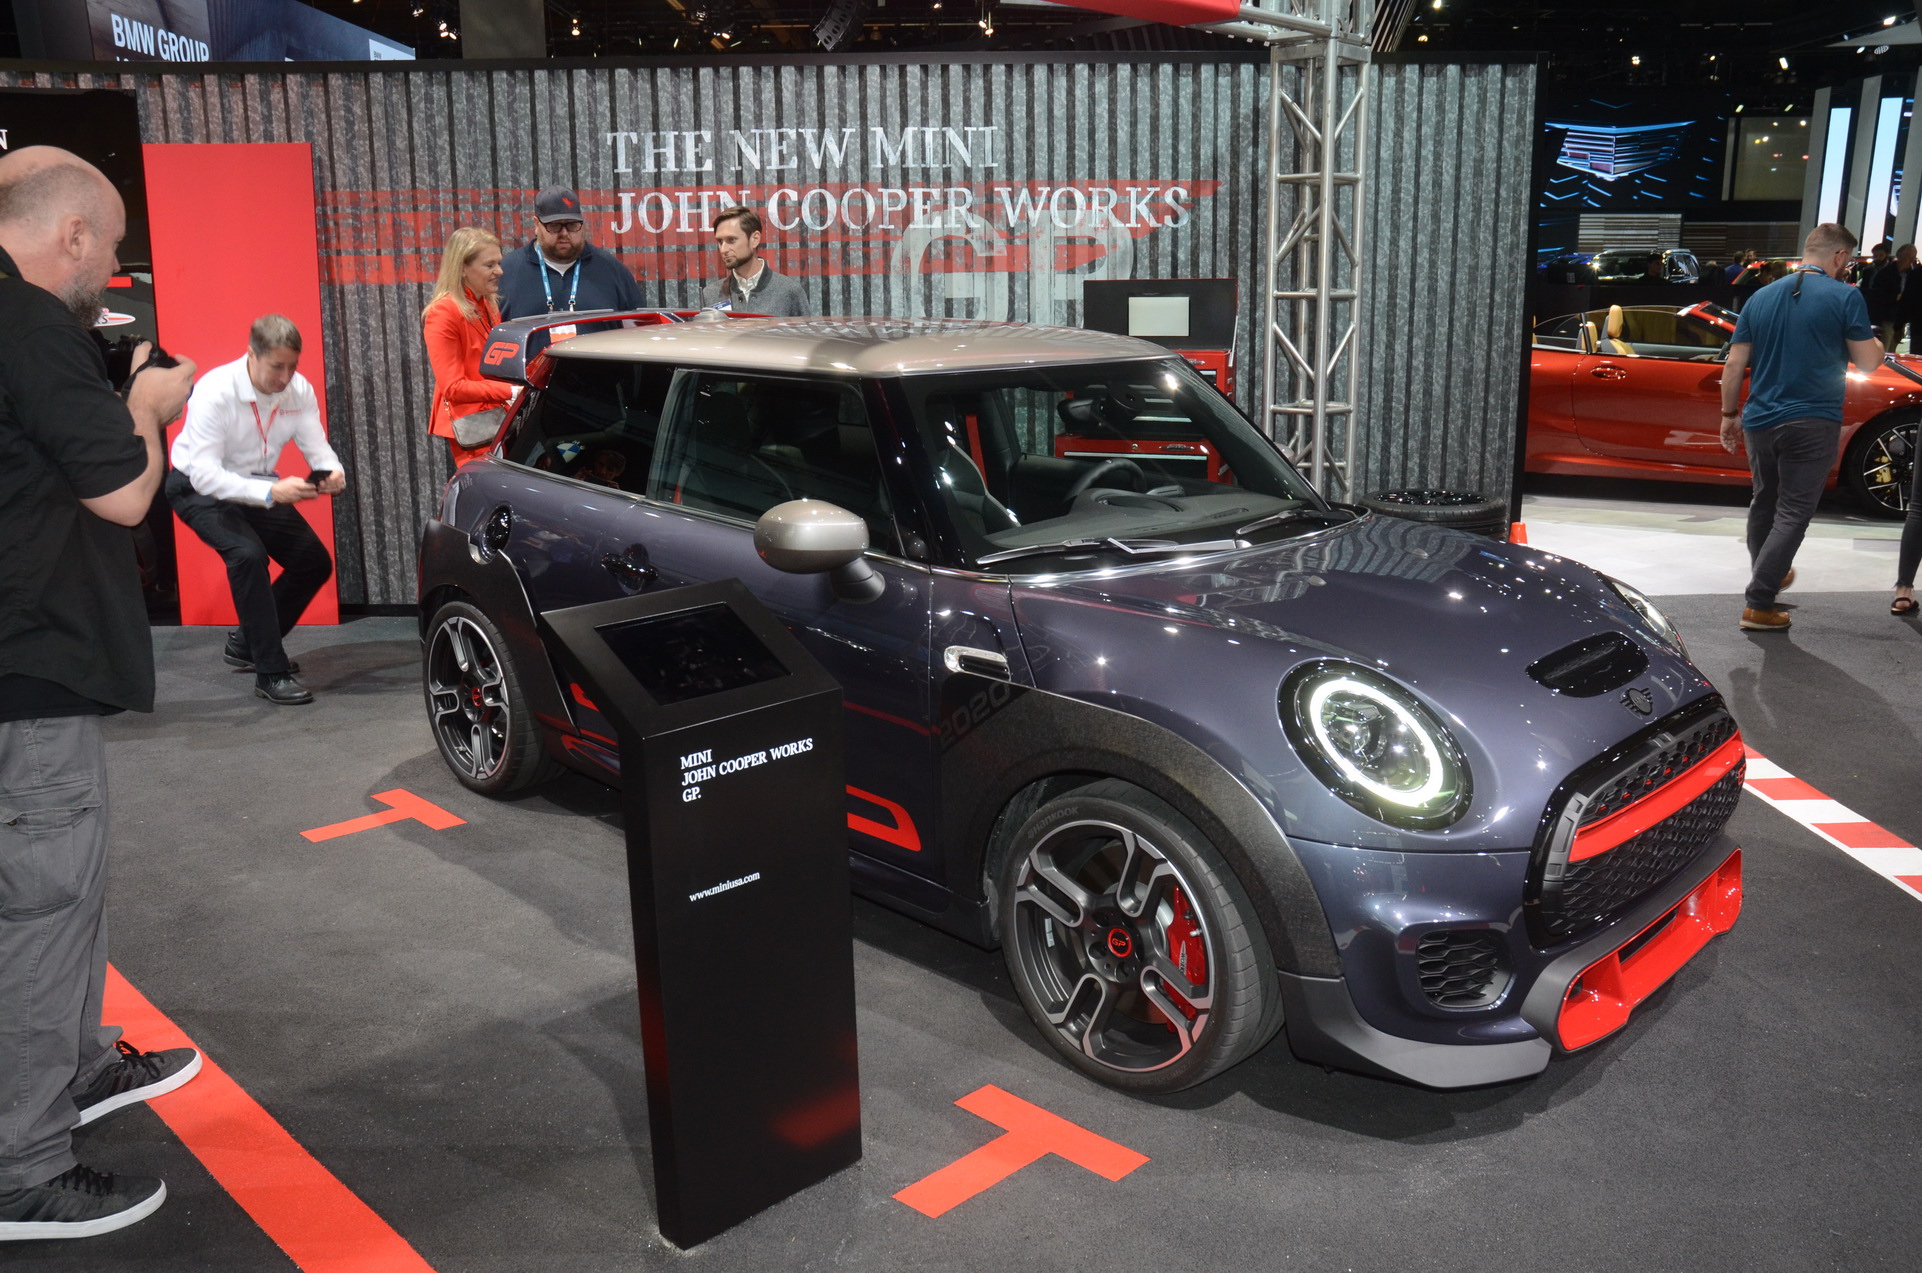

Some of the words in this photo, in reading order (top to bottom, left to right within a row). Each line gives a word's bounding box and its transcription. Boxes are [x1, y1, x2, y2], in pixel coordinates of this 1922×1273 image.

[111, 13, 155, 57] BMW
[157, 28, 210, 62] GROUP
[606, 130, 713, 173] THE
[729, 127, 856, 171] NEW
[870, 126, 999, 168] MINI
[767, 187, 981, 231] COOPER
[994, 186, 1191, 229] WORKS
[483, 341, 520, 366] GP
[680, 749, 713, 770] MINI
[681, 765, 717, 786] JOHN
[718, 751, 768, 775] COOPER
[769, 737, 814, 760] WORKS
[682, 786, 702, 802] GP.
[688, 871, 761, 902] www.miniusa.com
